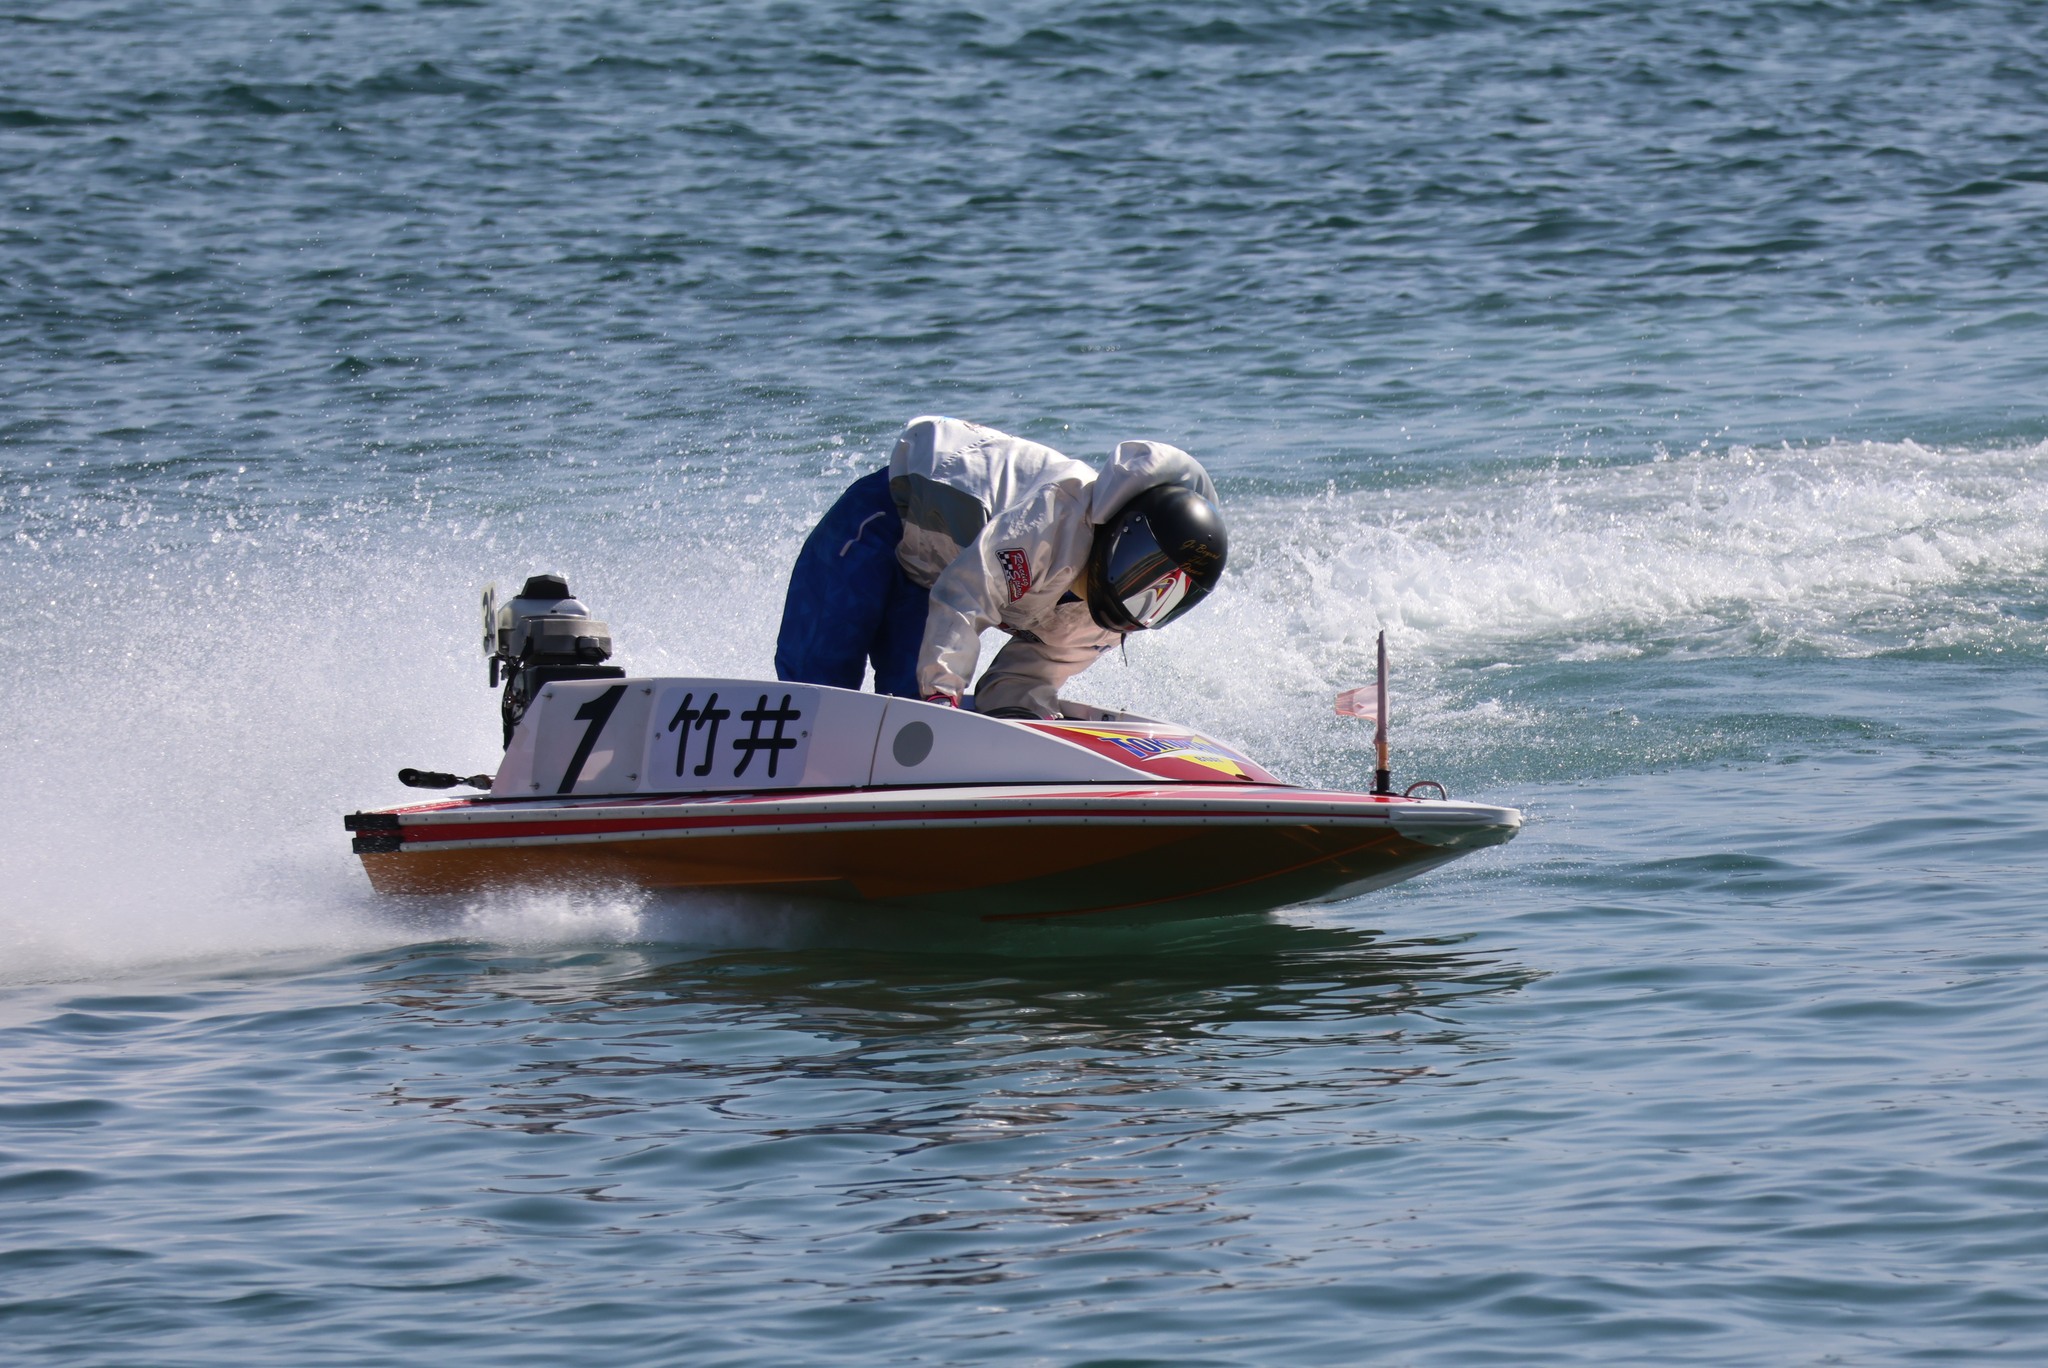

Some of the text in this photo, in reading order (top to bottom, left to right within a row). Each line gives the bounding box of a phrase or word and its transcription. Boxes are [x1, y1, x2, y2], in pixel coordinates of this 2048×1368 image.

[1011, 553, 1029, 586] Racing
[557, 685, 628, 794] 1
[668, 692, 802, 778] 竹井
